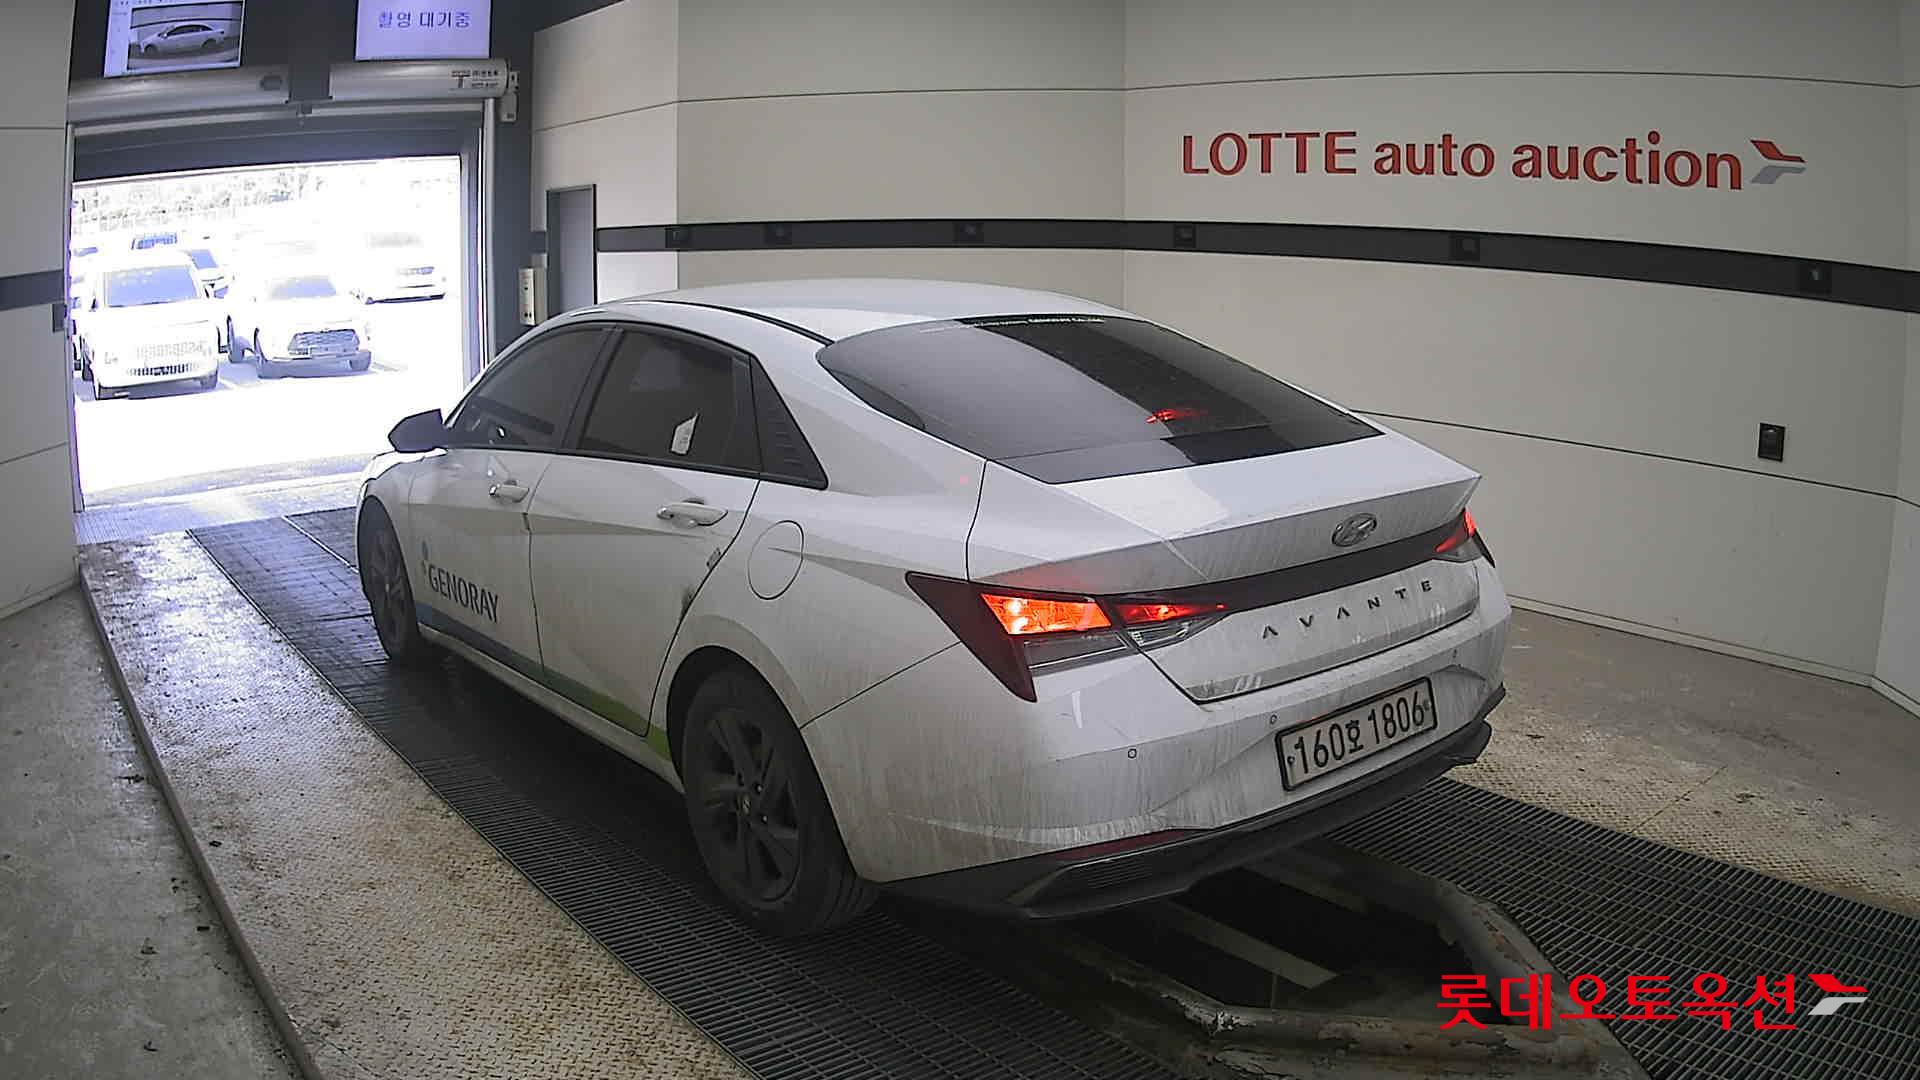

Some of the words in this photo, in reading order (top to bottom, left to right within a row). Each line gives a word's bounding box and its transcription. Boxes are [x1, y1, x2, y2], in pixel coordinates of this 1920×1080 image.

[419, 10, 471, 29] 대기중
[1183, 132, 1357, 175] LOTTE
[1374, 134, 1496, 177] auto
[1512, 132, 1743, 190] auction
[428, 564, 499, 623] GENORAY
[1261, 579, 1433, 640] AVANTE
[1368, 690, 1427, 745] 1806
